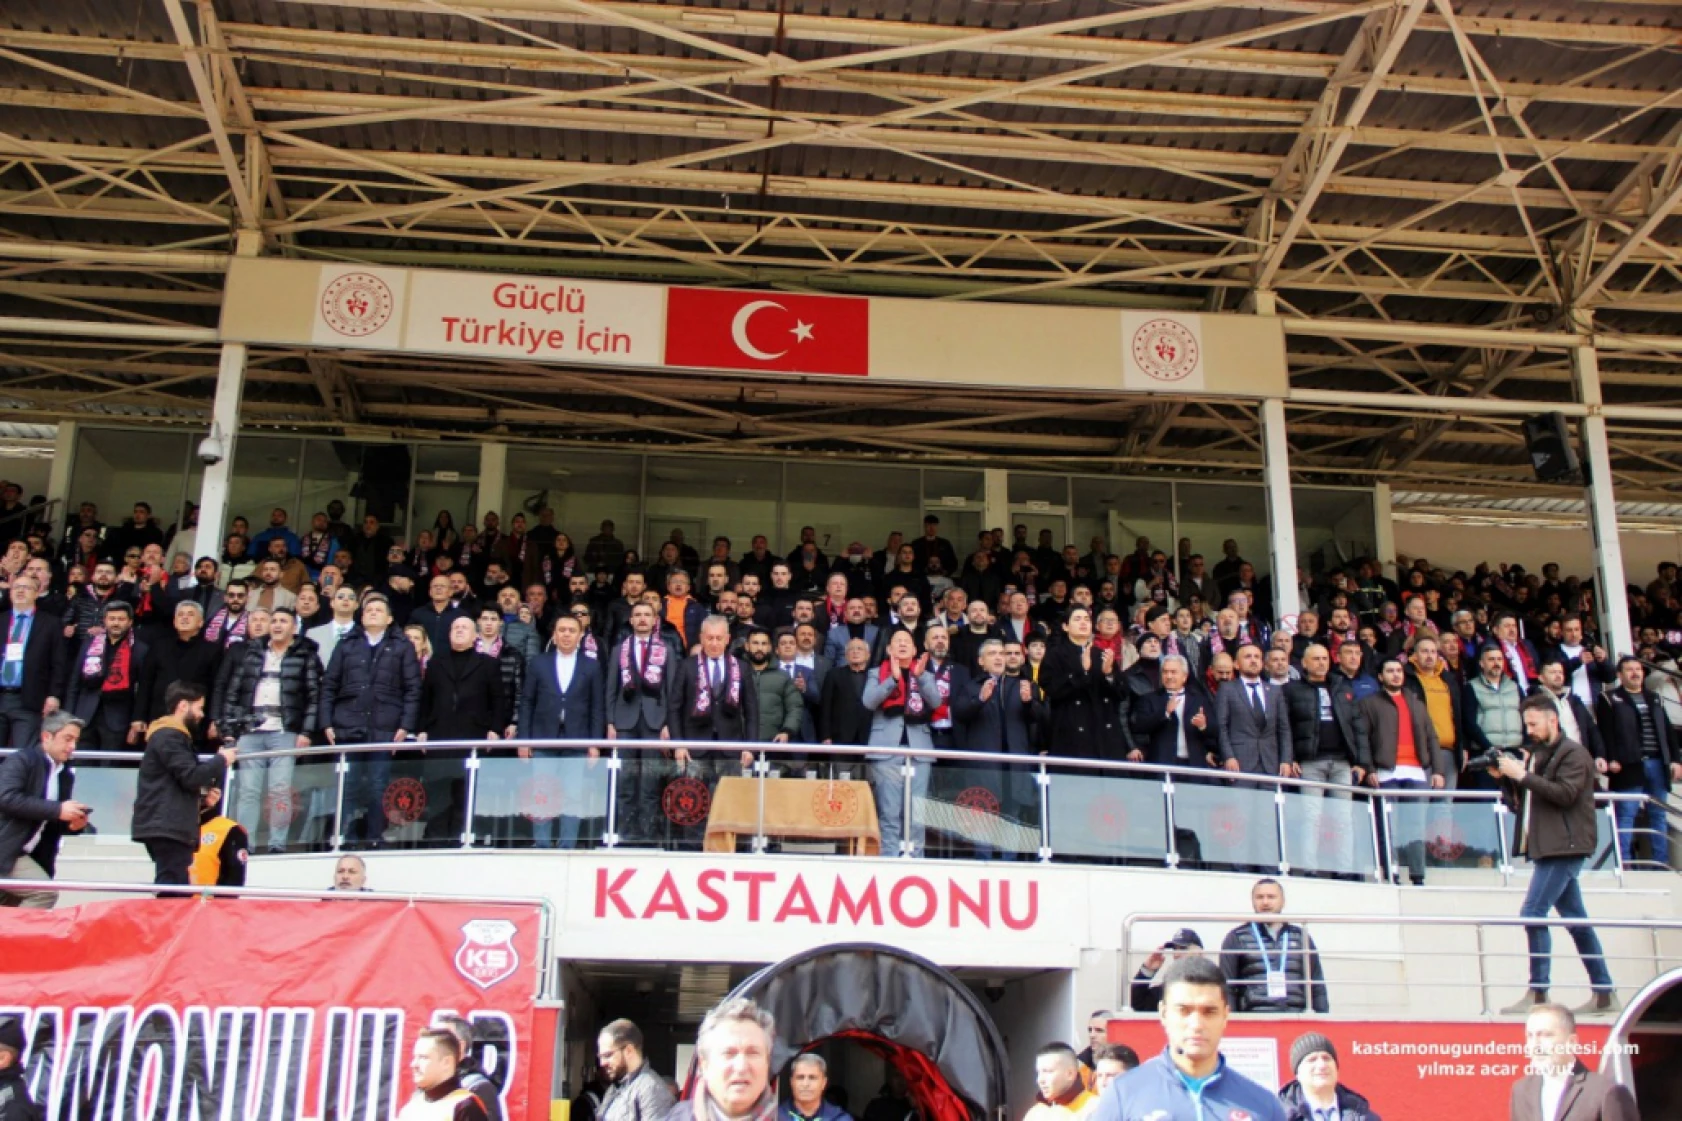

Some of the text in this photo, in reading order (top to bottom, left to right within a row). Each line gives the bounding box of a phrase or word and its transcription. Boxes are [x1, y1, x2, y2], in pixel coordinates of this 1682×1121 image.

[492, 282, 586, 315] Güçlü
[441, 316, 632, 355] Türkiye İçin
[593, 867, 1039, 931] KASTAMONU
